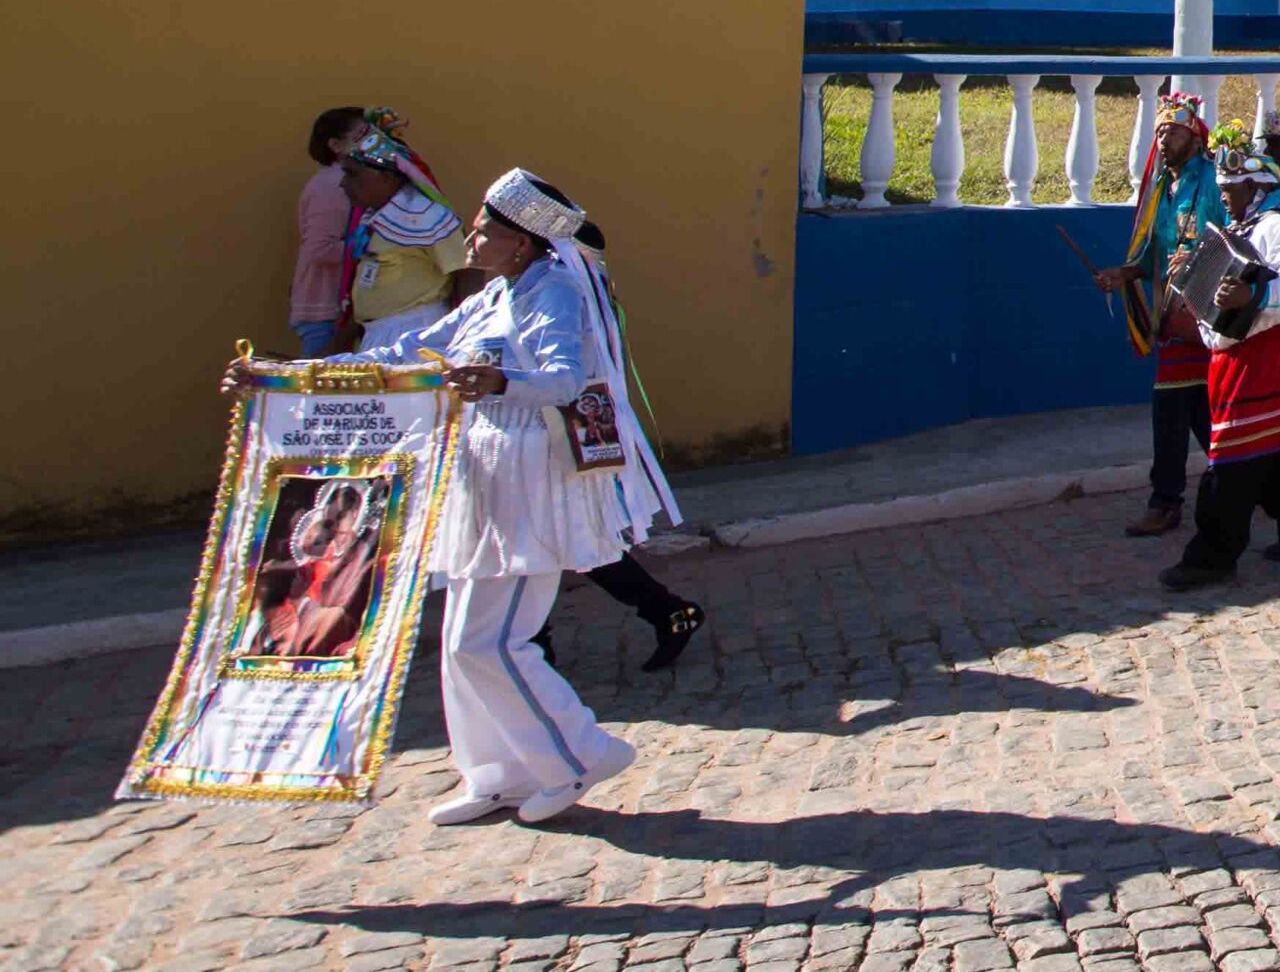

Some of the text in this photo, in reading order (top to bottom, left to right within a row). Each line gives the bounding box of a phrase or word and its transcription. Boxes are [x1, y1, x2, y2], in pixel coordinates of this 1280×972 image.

[312, 399, 386, 417] ASSOCIAÇÃO
[303, 418, 320, 430] DE
[282, 430, 311, 446] SÃO
